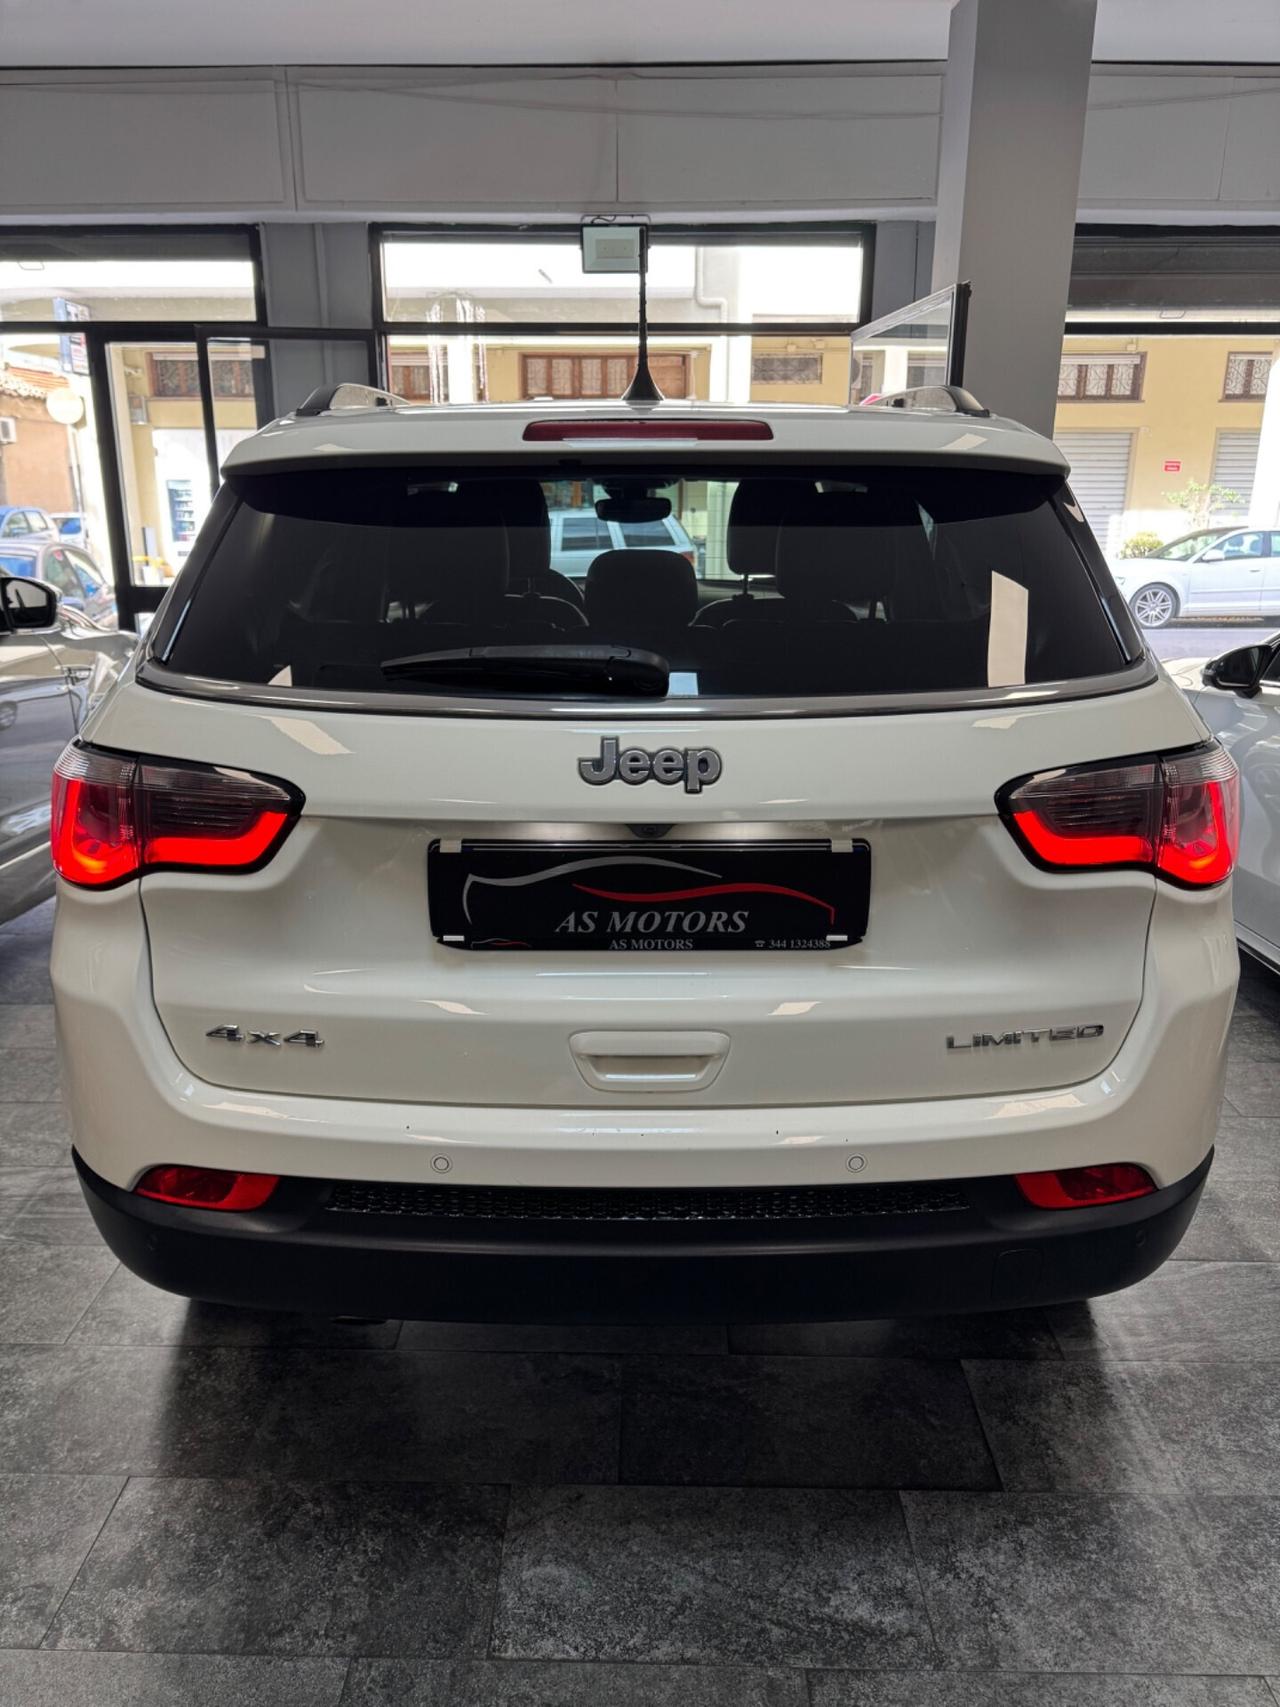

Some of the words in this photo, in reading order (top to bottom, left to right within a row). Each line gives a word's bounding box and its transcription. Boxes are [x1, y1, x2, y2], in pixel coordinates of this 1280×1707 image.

[578, 736, 722, 794] Jeep
[555, 911, 598, 933] AS
[606, 911, 749, 933] MOTORS
[609, 939, 627, 950] AS
[631, 939, 693, 950] MOTORS
[768, 939, 787, 949] 344
[946, 1024, 1104, 1049] LIMITED
